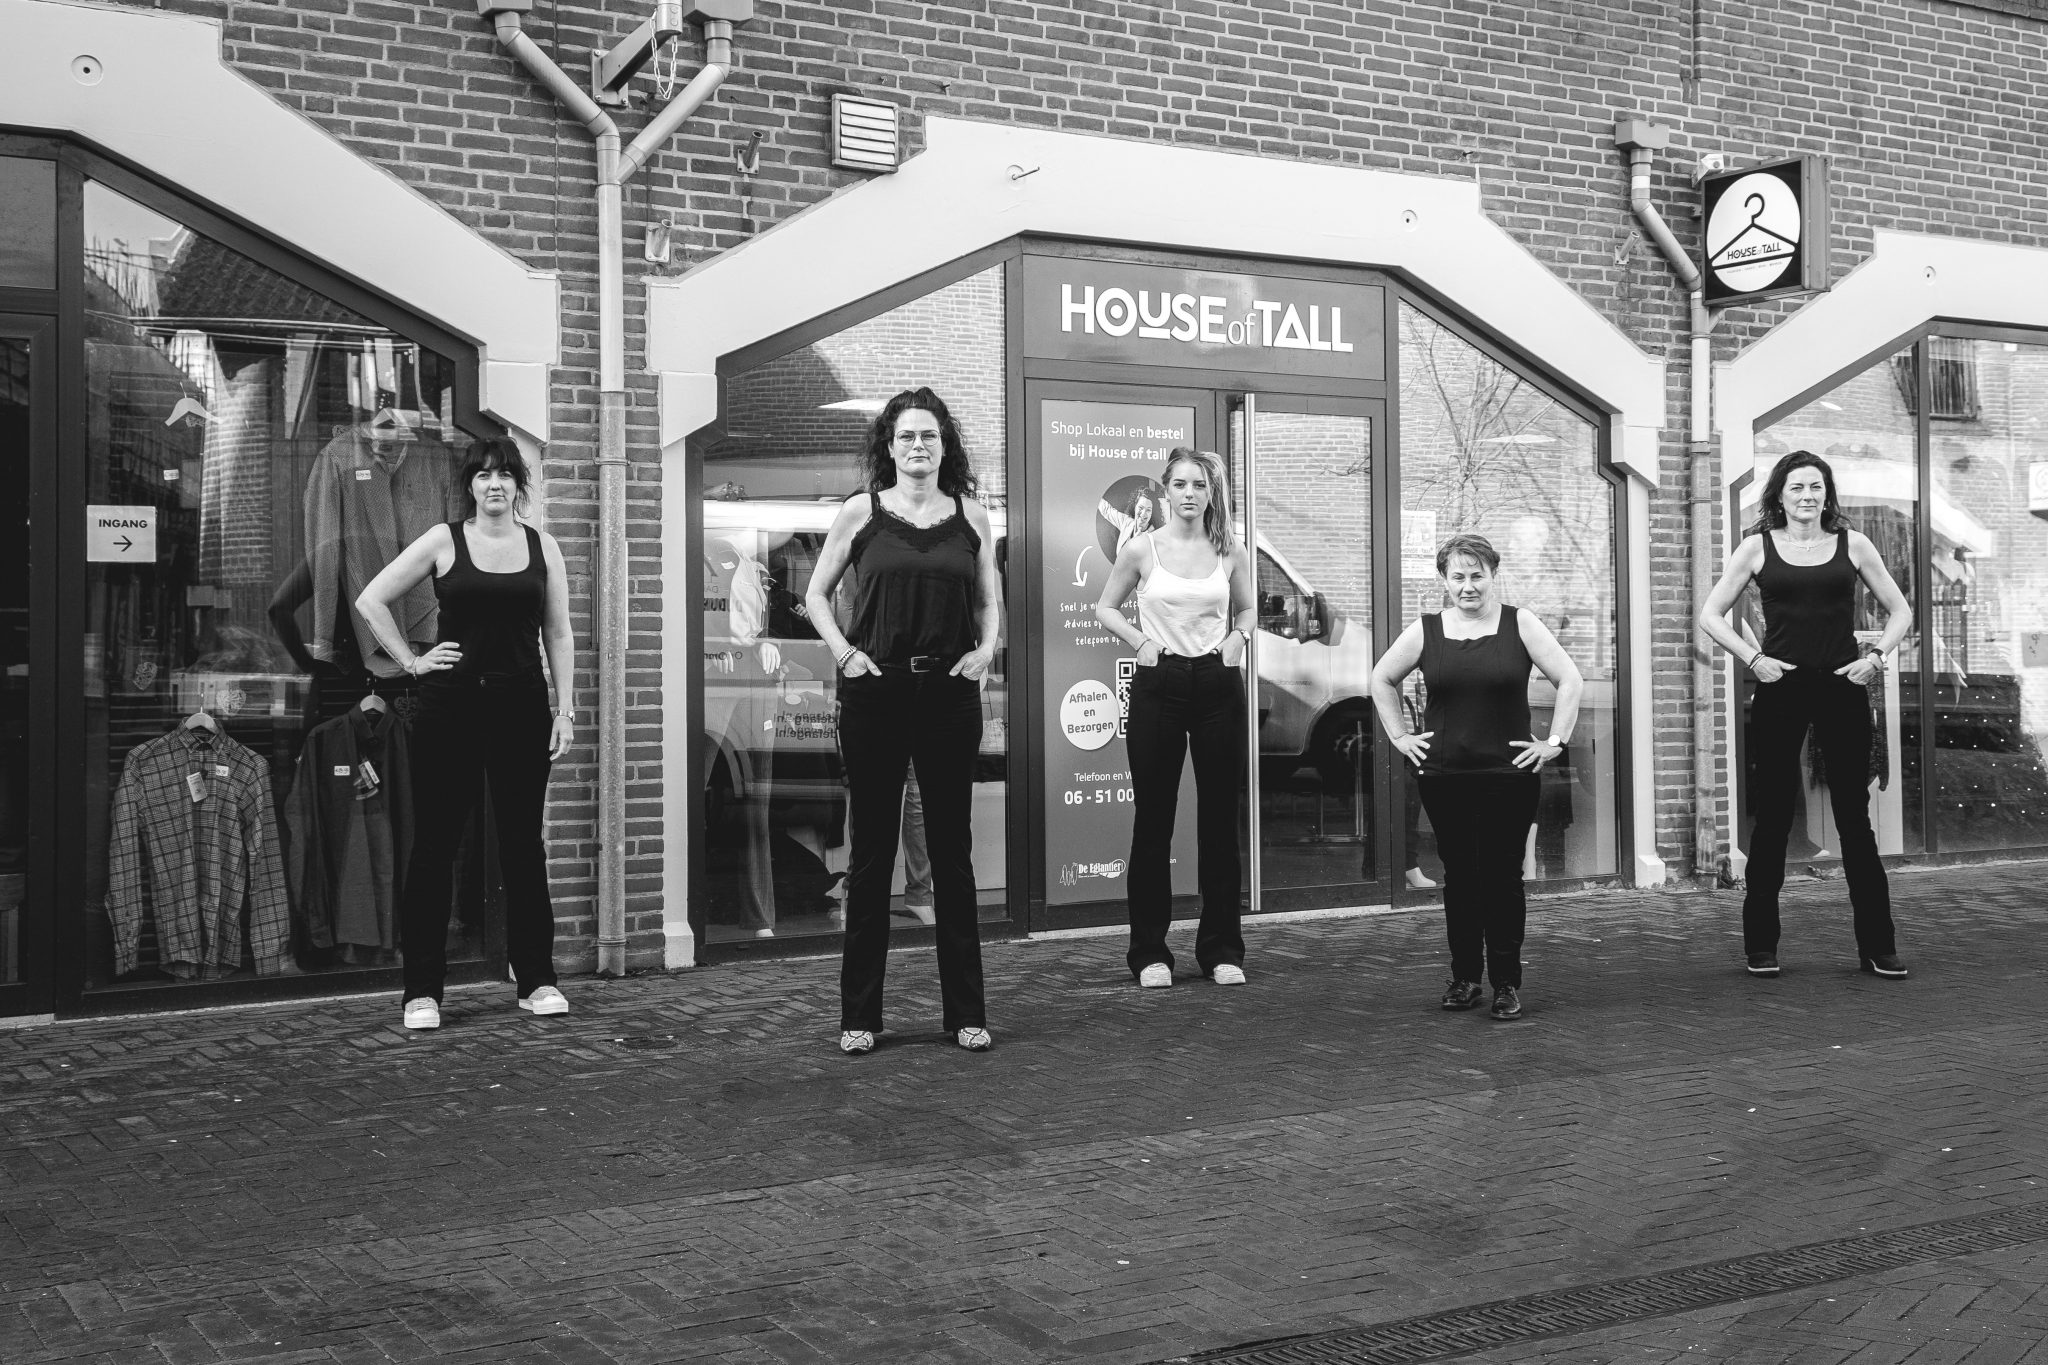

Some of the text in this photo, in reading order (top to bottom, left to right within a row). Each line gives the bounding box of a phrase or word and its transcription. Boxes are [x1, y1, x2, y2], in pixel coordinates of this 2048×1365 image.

[1727, 246, 1757, 260] HOUSE
[1762, 242, 1782, 254] TALL
[1061, 283, 1354, 353] HOUSE of TALL
[1051, 421, 1184, 440] Shop Lokaal en bestel
[1069, 443, 1167, 460] bij House of tall
[98, 519, 148, 529] INGANG
[1060, 601, 1077, 612] Snel
[1080, 602, 1087, 612] je
[1063, 619, 1091, 628] Advies
[1075, 635, 1109, 647] telefoon
[1069, 691, 1108, 704] Afhalen
[1083, 708, 1096, 717] en
[1067, 721, 1114, 734] Bezorgen
[1074, 772, 1111, 783] Telefoon
[1112, 773, 1123, 781] en
[1064, 790, 1083, 805] 06
[1095, 788, 1112, 804] 51
[1116, 788, 1135, 803] 00
[1078, 863, 1088, 874] De
